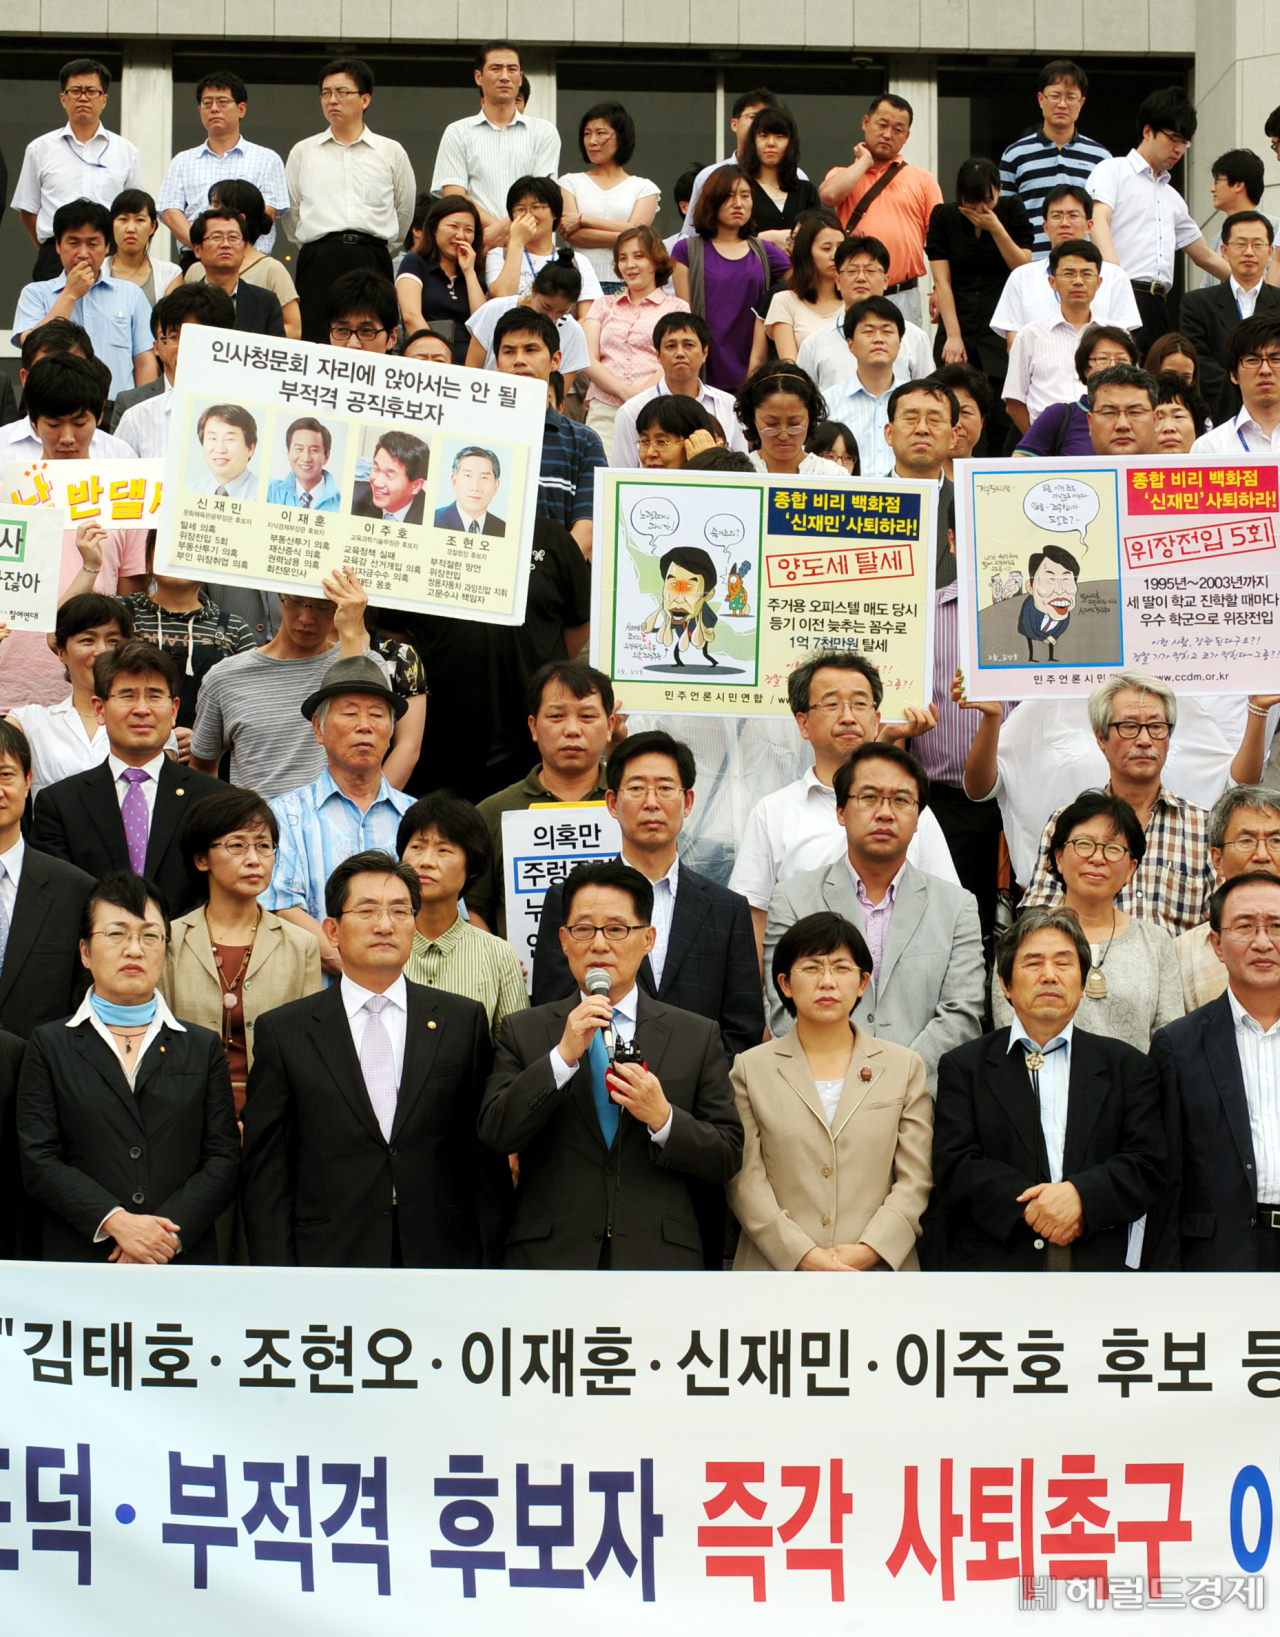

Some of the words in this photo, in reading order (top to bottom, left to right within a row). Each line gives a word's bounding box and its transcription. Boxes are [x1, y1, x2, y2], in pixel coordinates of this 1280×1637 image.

[212, 341, 309, 376] 인사청문회
[317, 358, 376, 387] 자리에
[385, 368, 461, 399] 앉아서는
[471, 381, 491, 404] 안
[498, 386, 517, 408] 될
[279, 380, 338, 409] 부적격
[346, 390, 444, 425] 공직후보자
[1132, 471, 1165, 489] 종합
[1171, 470, 1203, 488] 비리
[1209, 469, 1258, 487] 백화점
[774, 491, 807, 509] 종합
[813, 493, 845, 511] 비리
[851, 494, 901, 513] 백화점
[1206, 490, 1277, 509] 사퇴하라!
[180, 521, 197, 531] 탈세
[200, 524, 216, 533] 의혹
[235, 516, 252, 526] 후보자
[846, 516, 917, 536] 사퇴하라!
[179, 531, 212, 544] 위장전입
[215, 536, 229, 546] 5회
[307, 527, 325, 537] 후보자
[178, 541, 218, 555] 부동산투기
[222, 548, 238, 558] 의혹
[270, 534, 311, 547] 부동산투기
[314, 540, 330, 550] 의혹
[402, 541, 419, 550] 후보자
[1131, 528, 1225, 561] 위장전입
[1231, 523, 1271, 547] 5회
[269, 544, 302, 557] 재산증식
[305, 550, 321, 560] 의혹
[343, 545, 376, 557] 교육정책
[380, 550, 396, 560] 실패
[470, 552, 487, 561] 후보자
[177, 551, 193, 561] 부인
[196, 554, 229, 567] 위장취업
[232, 560, 249, 570] 의혹
[267, 554, 300, 567] 권력남용
[303, 560, 320, 570] 의혹
[342, 556, 367, 566] 교육감
[370, 559, 403, 572] 선거개입
[406, 564, 422, 574] 의혹
[430, 557, 462, 570] 부적절한
[465, 562, 482, 573] 망언
[778, 554, 849, 581] 양도세
[855, 550, 903, 575] 탈세
[266, 564, 307, 578] 회전문인사
[393, 572, 409, 582] 의혹
[429, 568, 461, 580] 위장전입
[376, 580, 392, 591] 옹호
[428, 578, 462, 591] 쌍용자동차
[464, 583, 491, 596] 과잉진압
[494, 588, 508, 598] 지휘
[427, 588, 459, 600] 고문수사
[462, 593, 485, 604] 책임자
[1127, 596, 1140, 609] 세
[1142, 595, 1168, 609] 딸이
[1171, 594, 1197, 608] 학교
[1200, 594, 1238, 608] 진학할
[1241, 593, 1280, 607] 때마다
[767, 598, 806, 614] 주거용
[808, 600, 860, 615] 오피스텔
[864, 602, 889, 616] 매도
[892, 603, 918, 617] 당시
[769, 616, 796, 632] 등기
[799, 617, 825, 632] 이전
[828, 619, 866, 634] 늦추는
[869, 620, 907, 635] 꼼수로
[1140, 613, 1166, 627] 우수
[1169, 612, 1220, 626] 학군으로
[1223, 611, 1274, 625] 위장전입
[790, 636, 809, 650] 1억
[813, 636, 859, 652] 7천만원
[862, 638, 888, 653] 탈세
[664, 690, 763, 704] 민주언론시민연합
[533, 823, 602, 850] 의혹만
[522, 858, 614, 887] 주렁
[1098, 1328, 1213, 1398] 후보
[162, 1451, 391, 1596] 부적격
[430, 1455, 664, 1602] 후보자
[697, 1458, 853, 1602] 즉각
[885, 1454, 1193, 1602] 사퇴촉구
